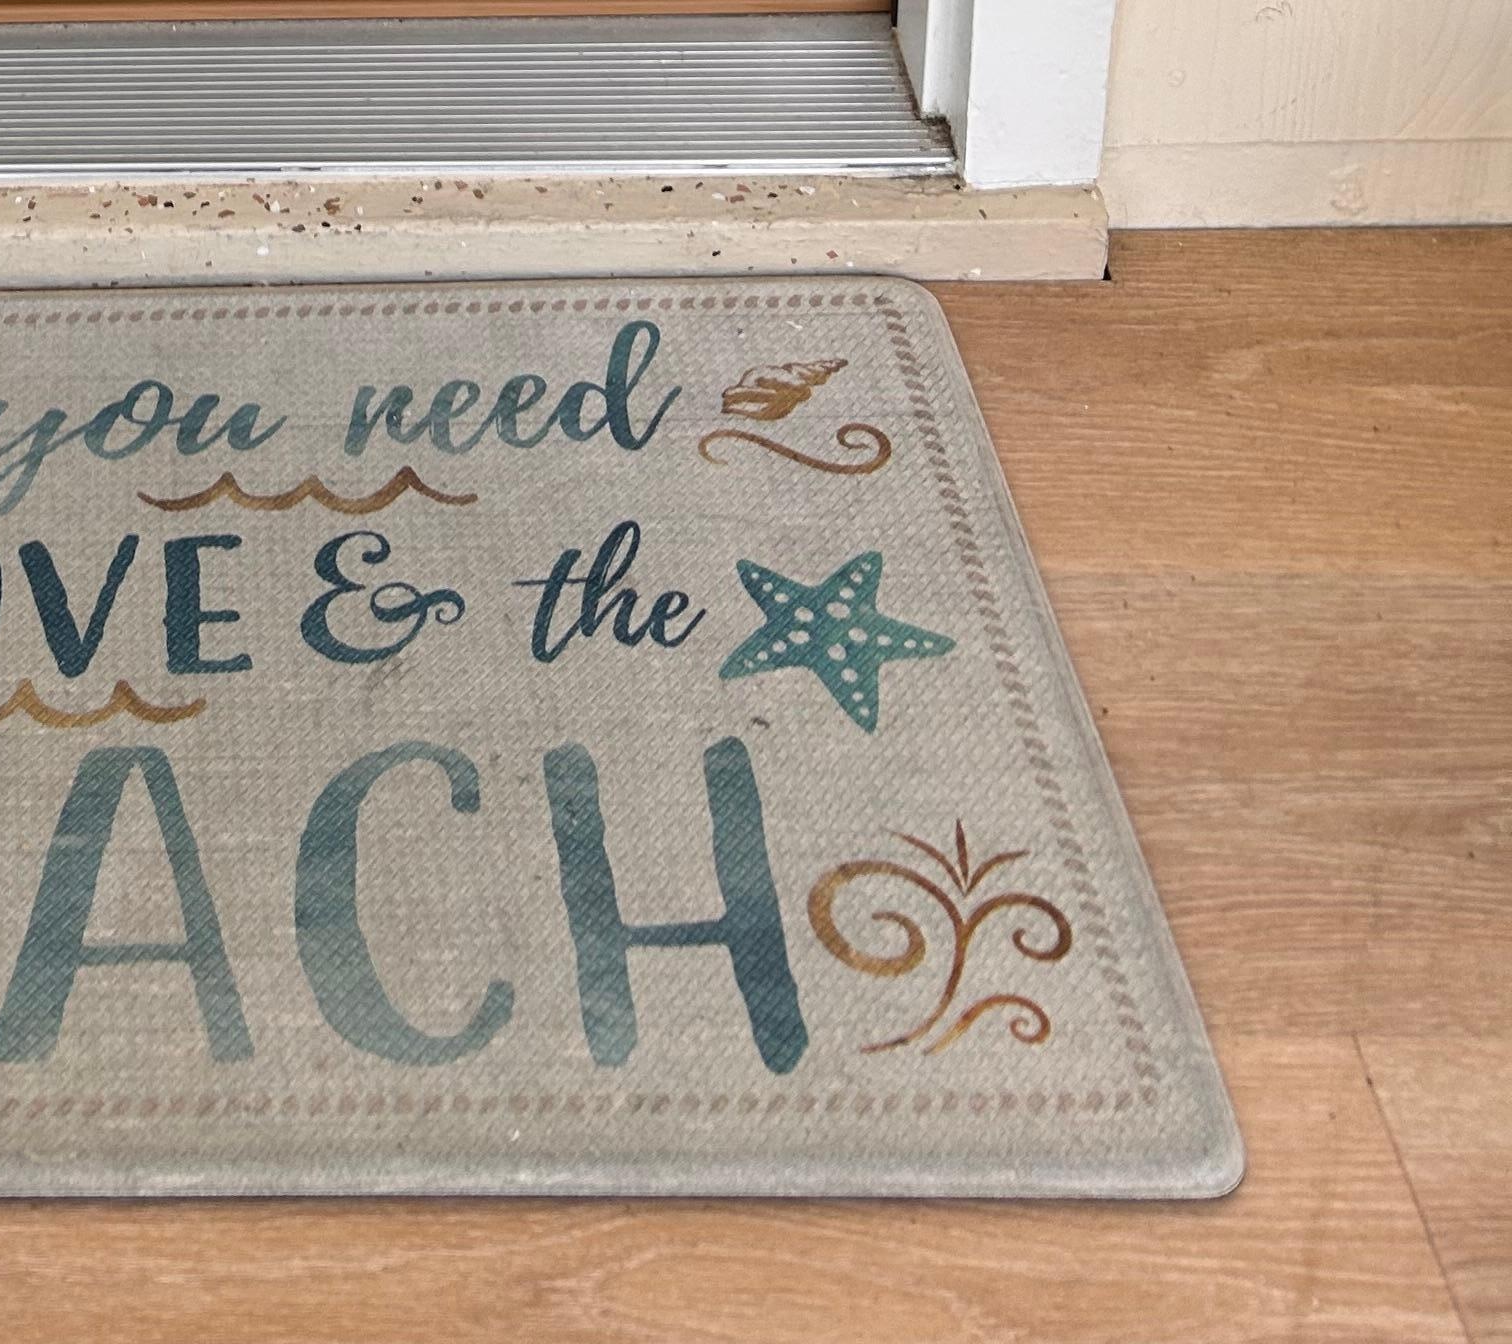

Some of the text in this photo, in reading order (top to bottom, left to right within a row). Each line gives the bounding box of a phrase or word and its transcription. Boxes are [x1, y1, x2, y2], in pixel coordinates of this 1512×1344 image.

[345, 320, 682, 458] need
[301, 530, 466, 665] &
[513, 519, 707, 666] the
